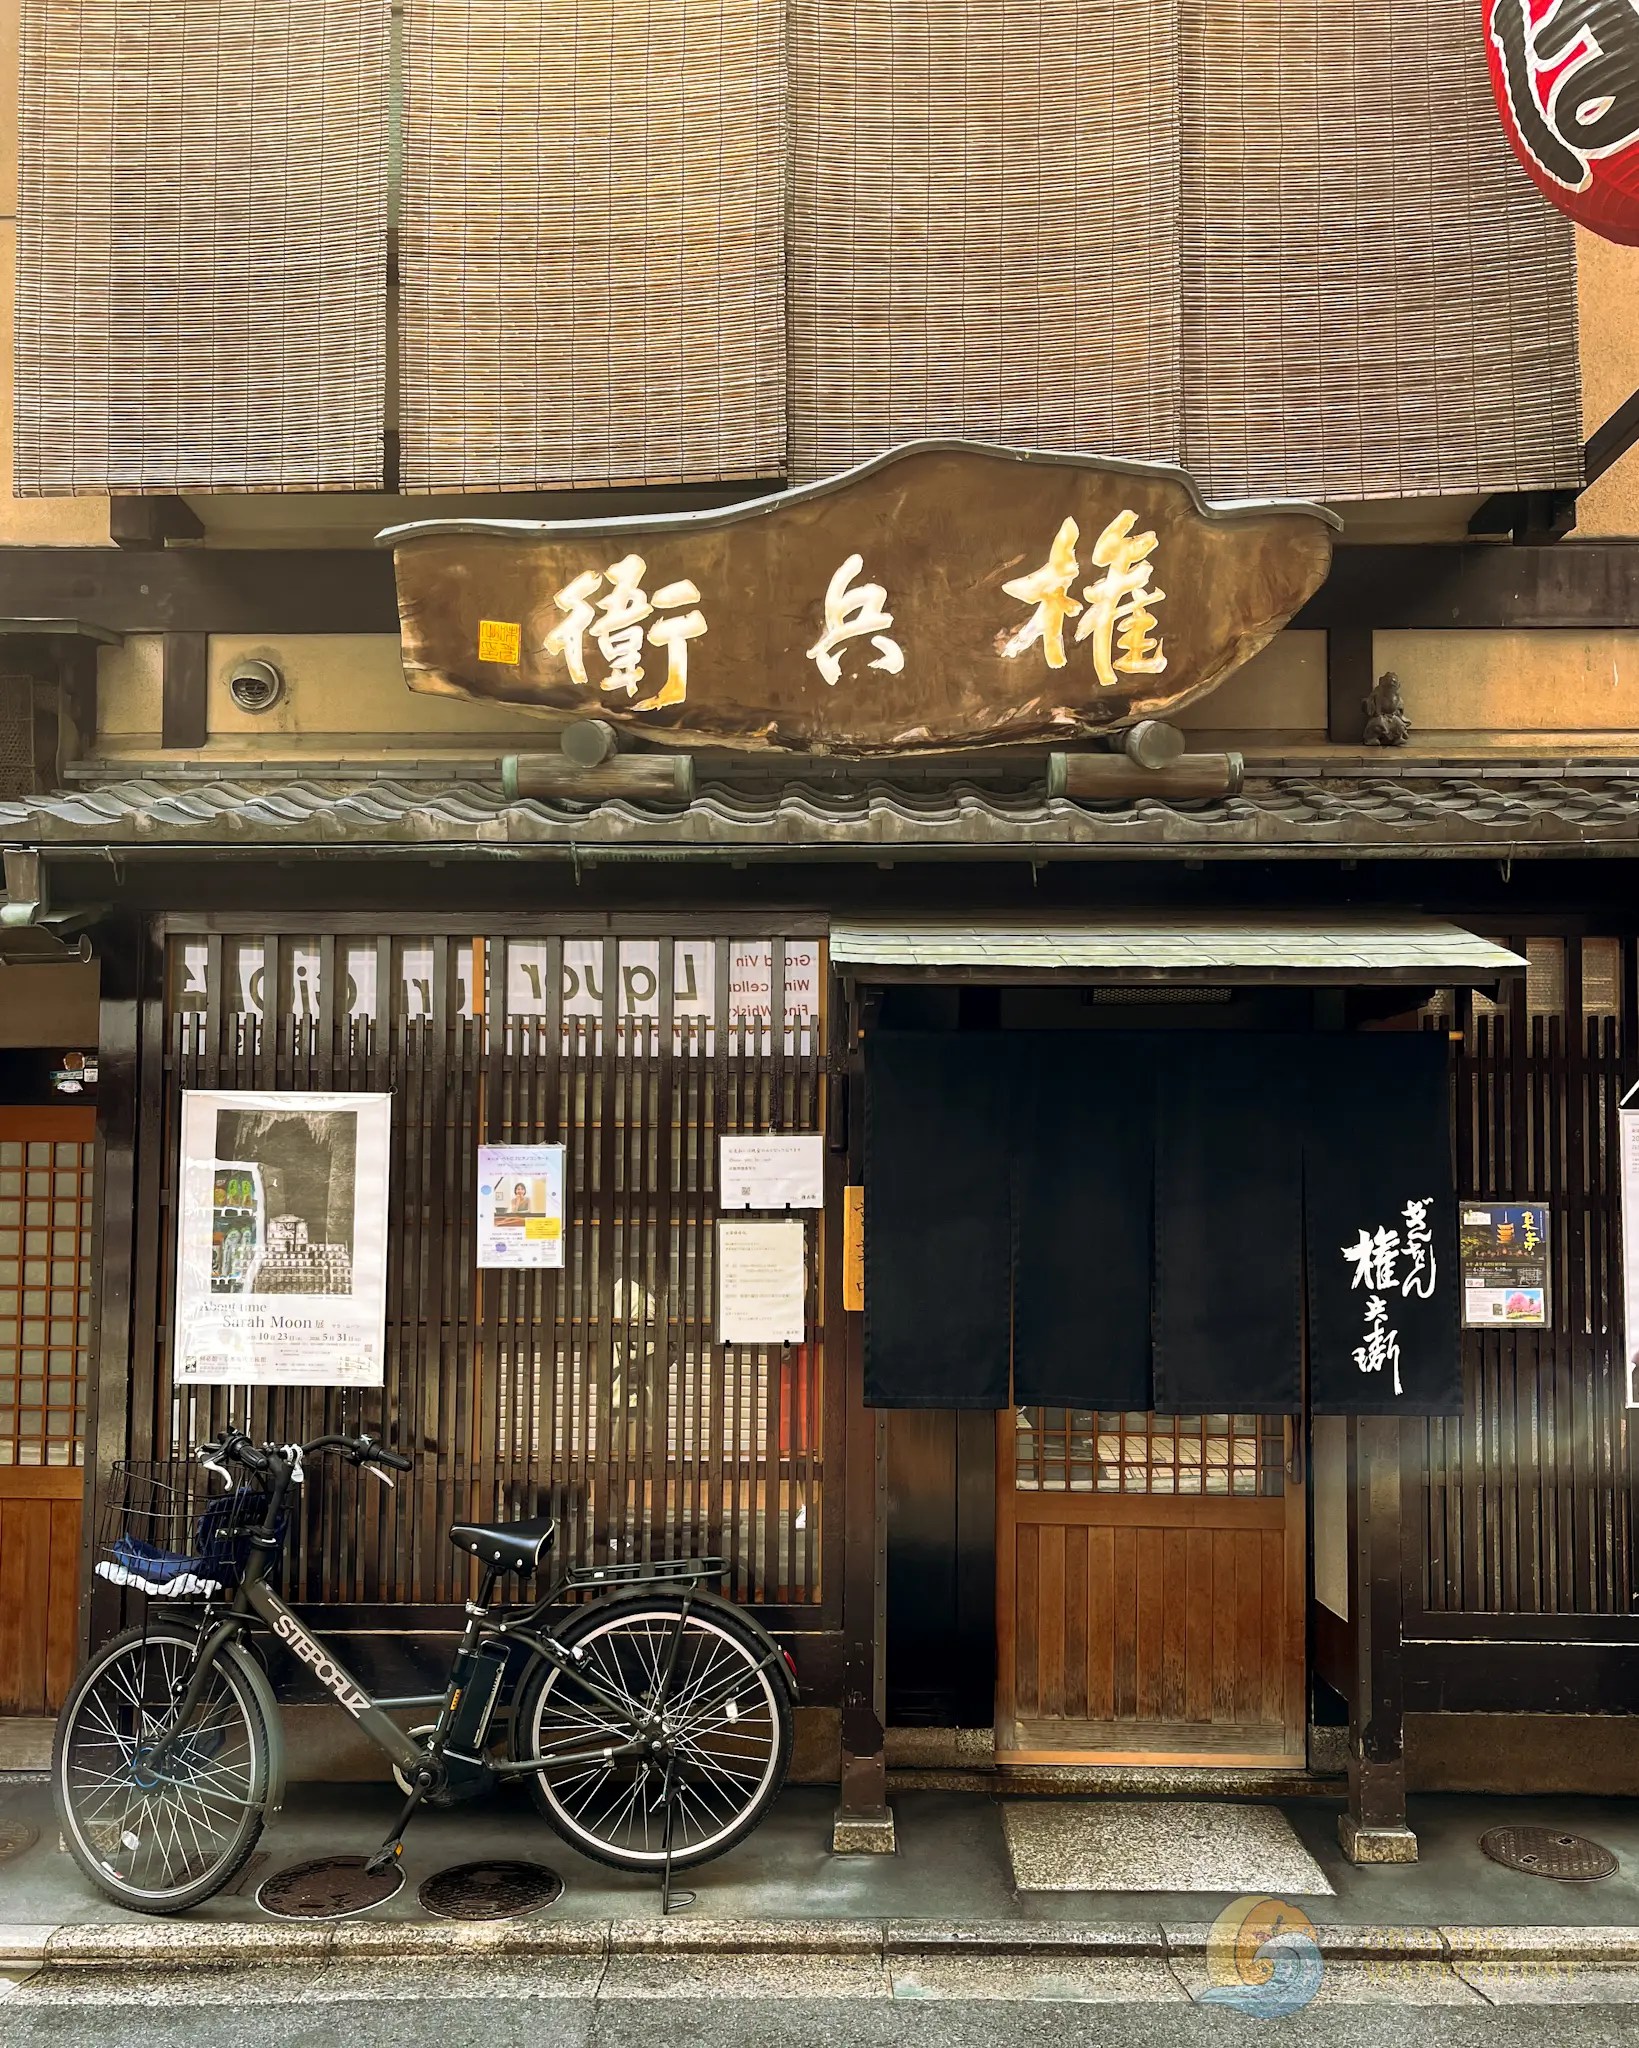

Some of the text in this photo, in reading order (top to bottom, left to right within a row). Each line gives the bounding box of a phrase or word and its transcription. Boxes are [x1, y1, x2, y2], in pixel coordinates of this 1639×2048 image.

[222, 1315, 265, 1329] Sarah
[270, 1315, 312, 1329] Moon
[273, 1614, 371, 1719] STEPCRUZ
